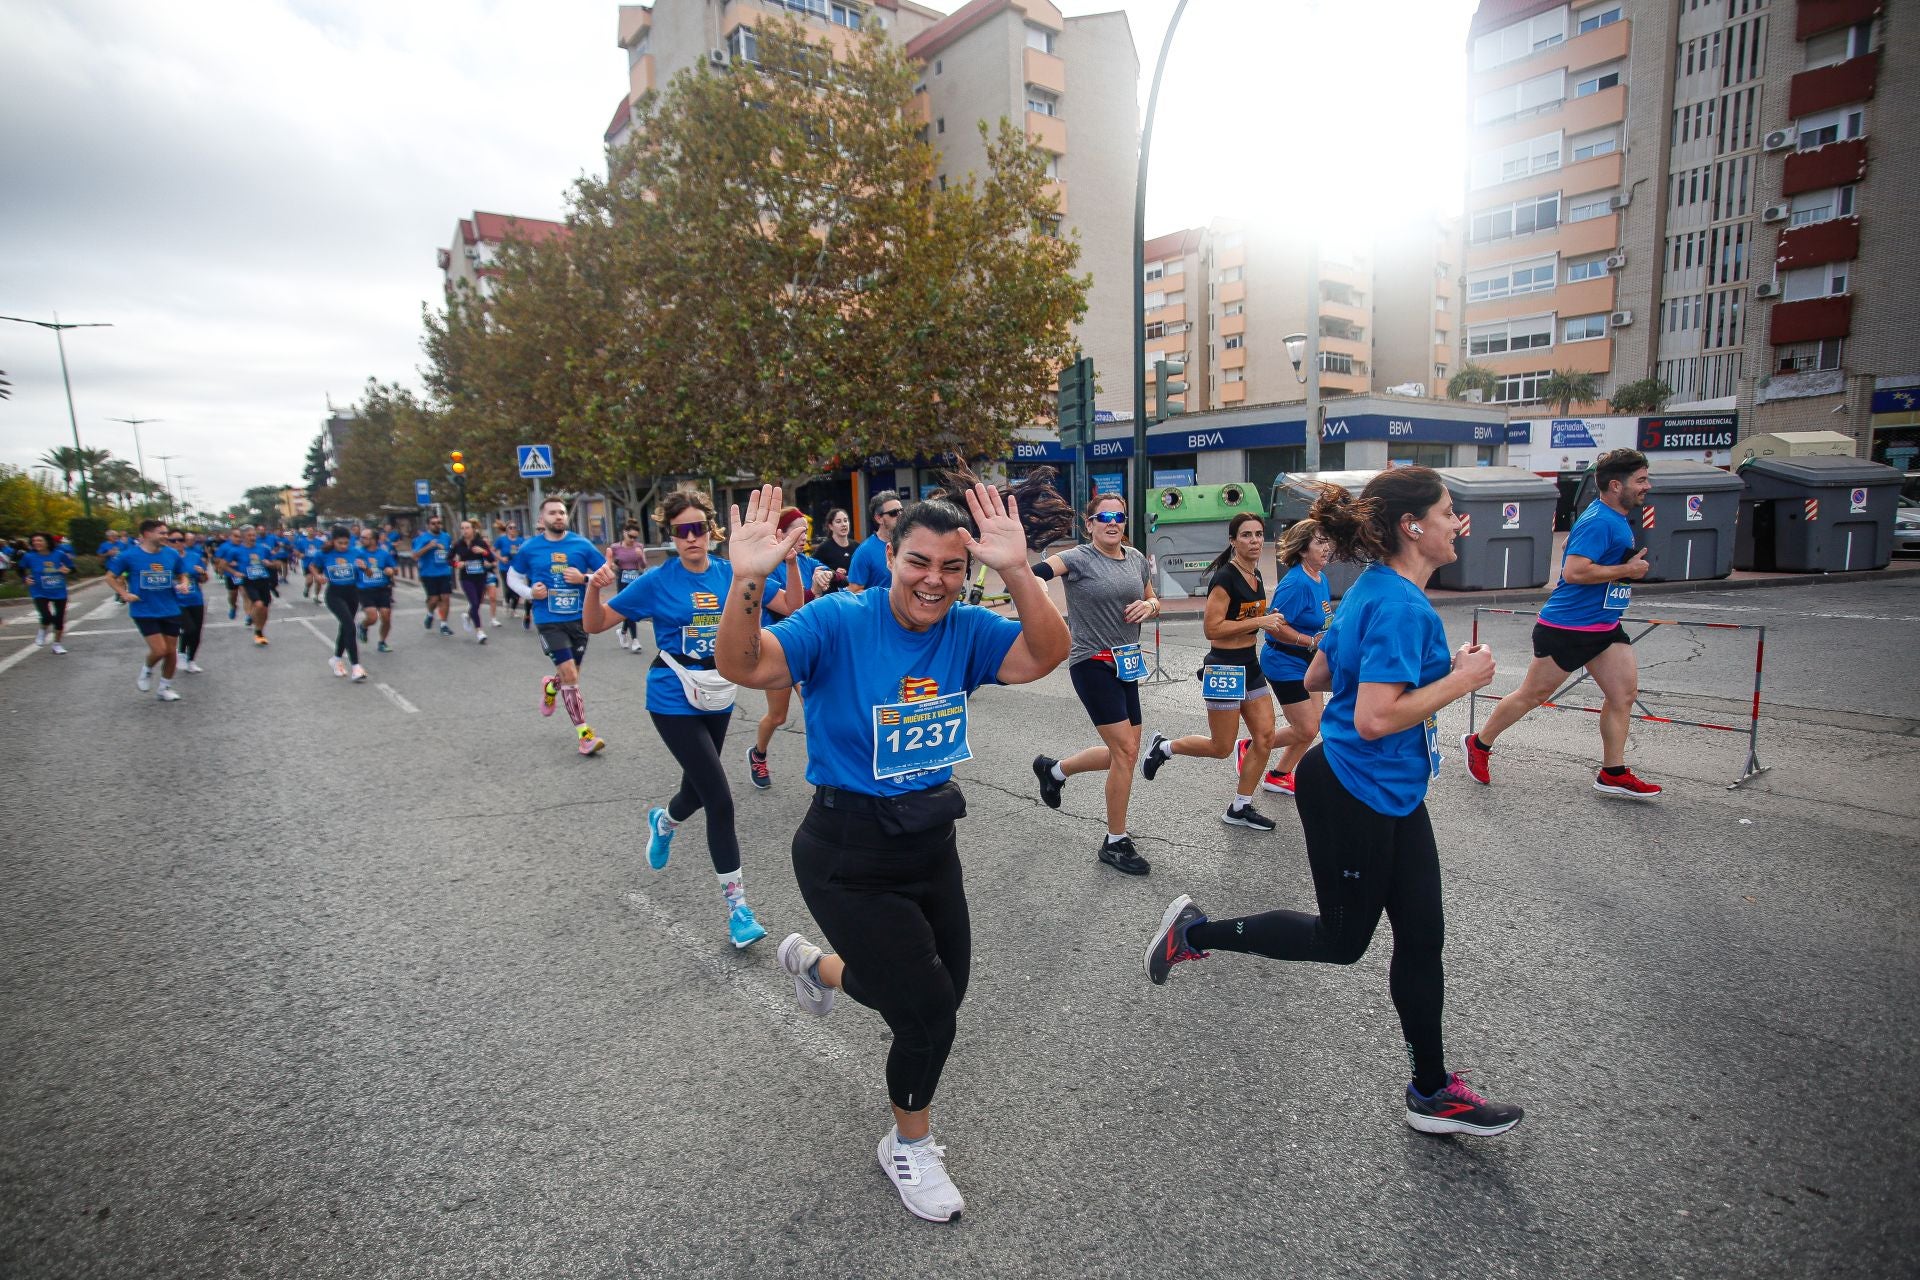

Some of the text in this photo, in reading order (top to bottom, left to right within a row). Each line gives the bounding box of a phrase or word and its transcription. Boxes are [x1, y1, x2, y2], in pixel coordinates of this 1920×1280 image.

[1321, 420, 1350, 437] BVA
[1389, 420, 1413, 435] BBVA
[1474, 426, 1493, 438] BBVA
[1508, 430, 1527, 438] BBVA
[1553, 421, 1584, 432] Fachadas
[1188, 432, 1224, 448] BBVA
[1643, 421, 1663, 448] 5
[1663, 432, 1732, 447] ESTRELLAS
[1018, 445, 1047, 457] BBVA
[1093, 441, 1123, 456] BBVA
[555, 597, 577, 606] 267
[1209, 676, 1237, 689] 653
[903, 713, 931, 724] MUÉVETE
[932, 711, 937, 719] X
[937, 705, 964, 718] VALENCIA
[886, 718, 960, 753] 1237
